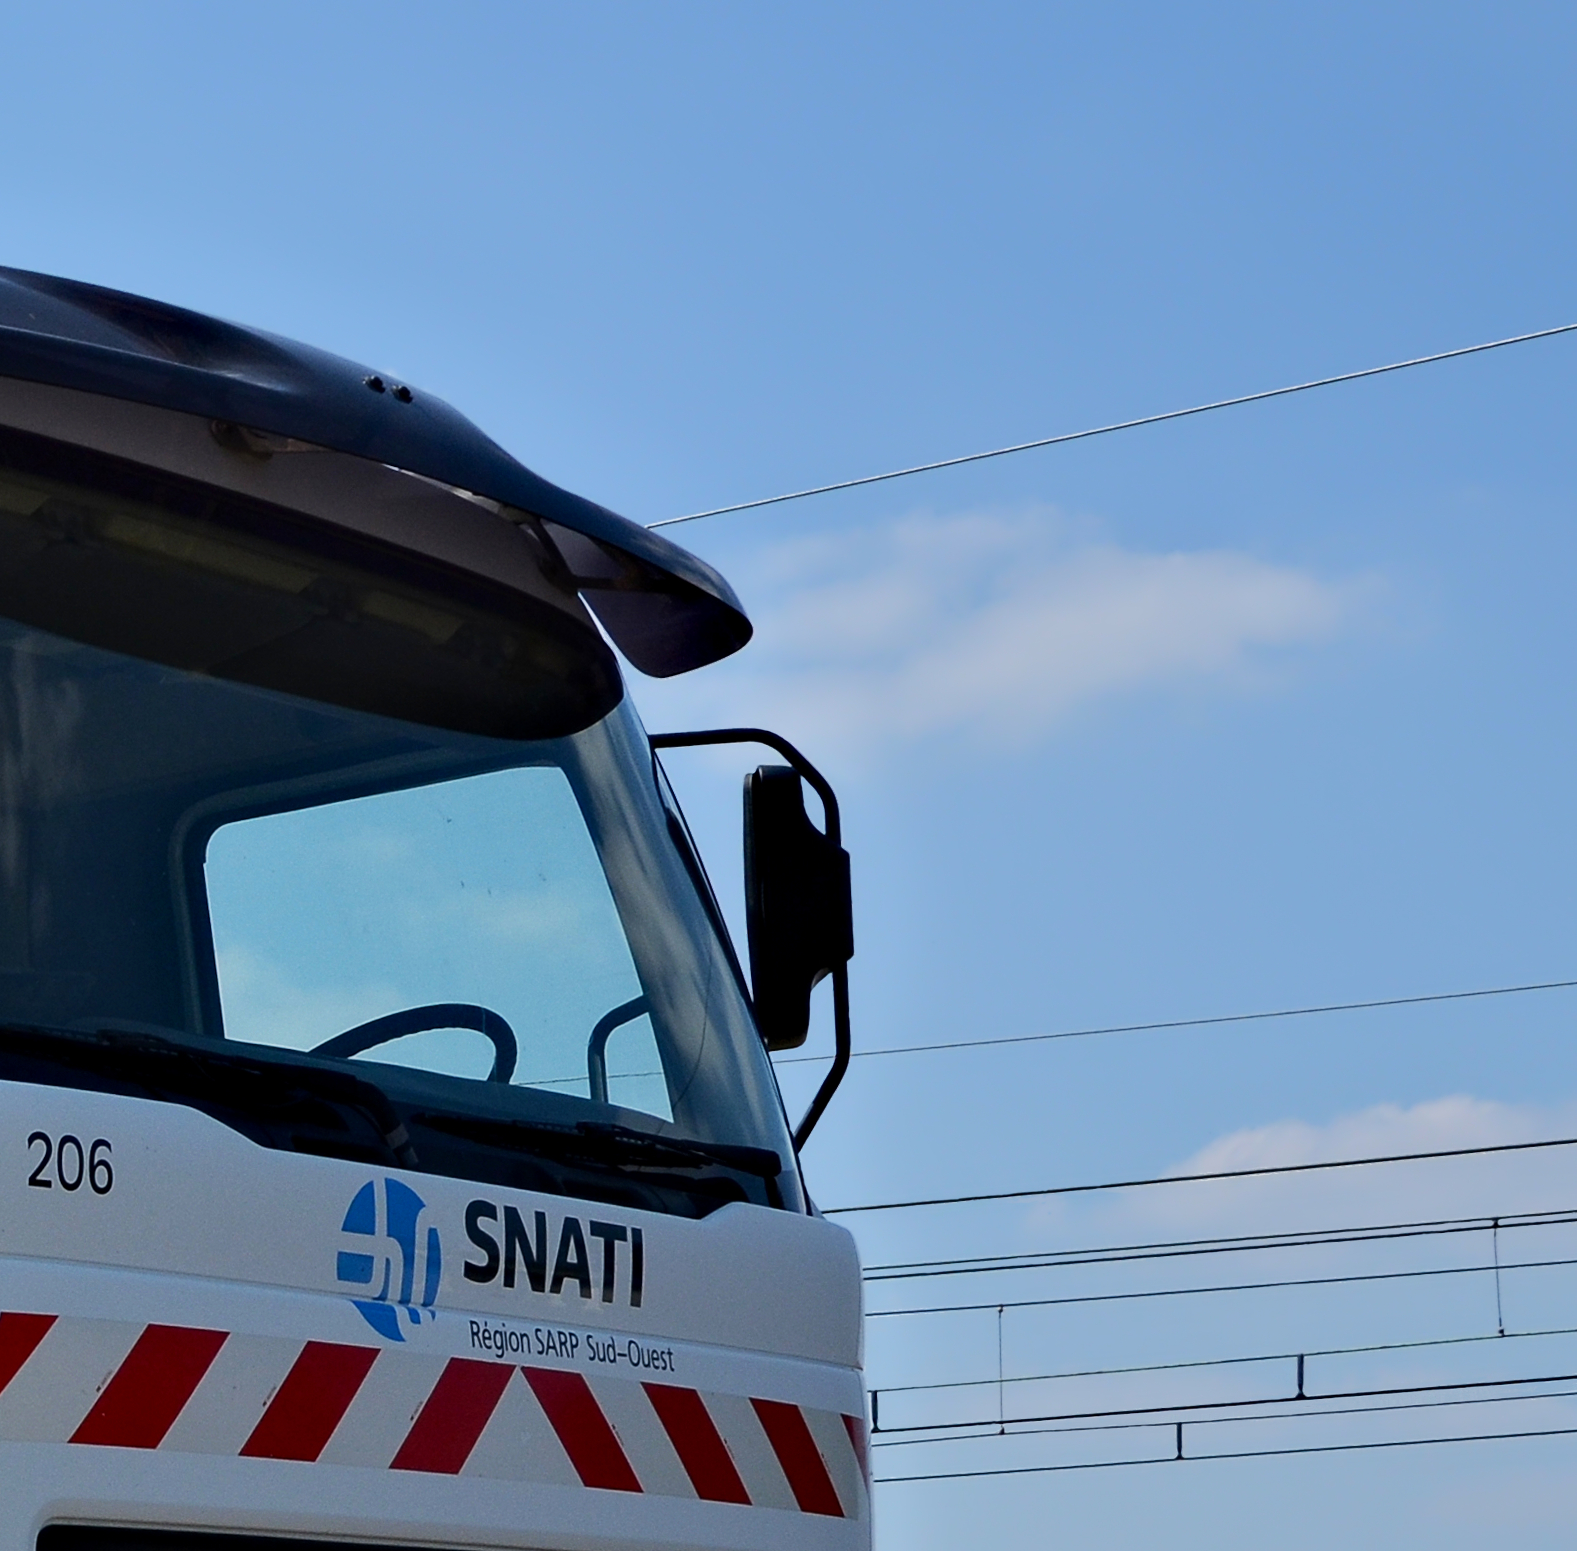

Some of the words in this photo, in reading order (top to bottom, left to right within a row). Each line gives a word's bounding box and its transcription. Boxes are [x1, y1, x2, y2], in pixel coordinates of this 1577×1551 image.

[27, 1131, 113, 1195] 206
[463, 1200, 644, 1308] SNATI
[469, 1321, 531, 1357] Région
[534, 1327, 579, 1360] SARP
